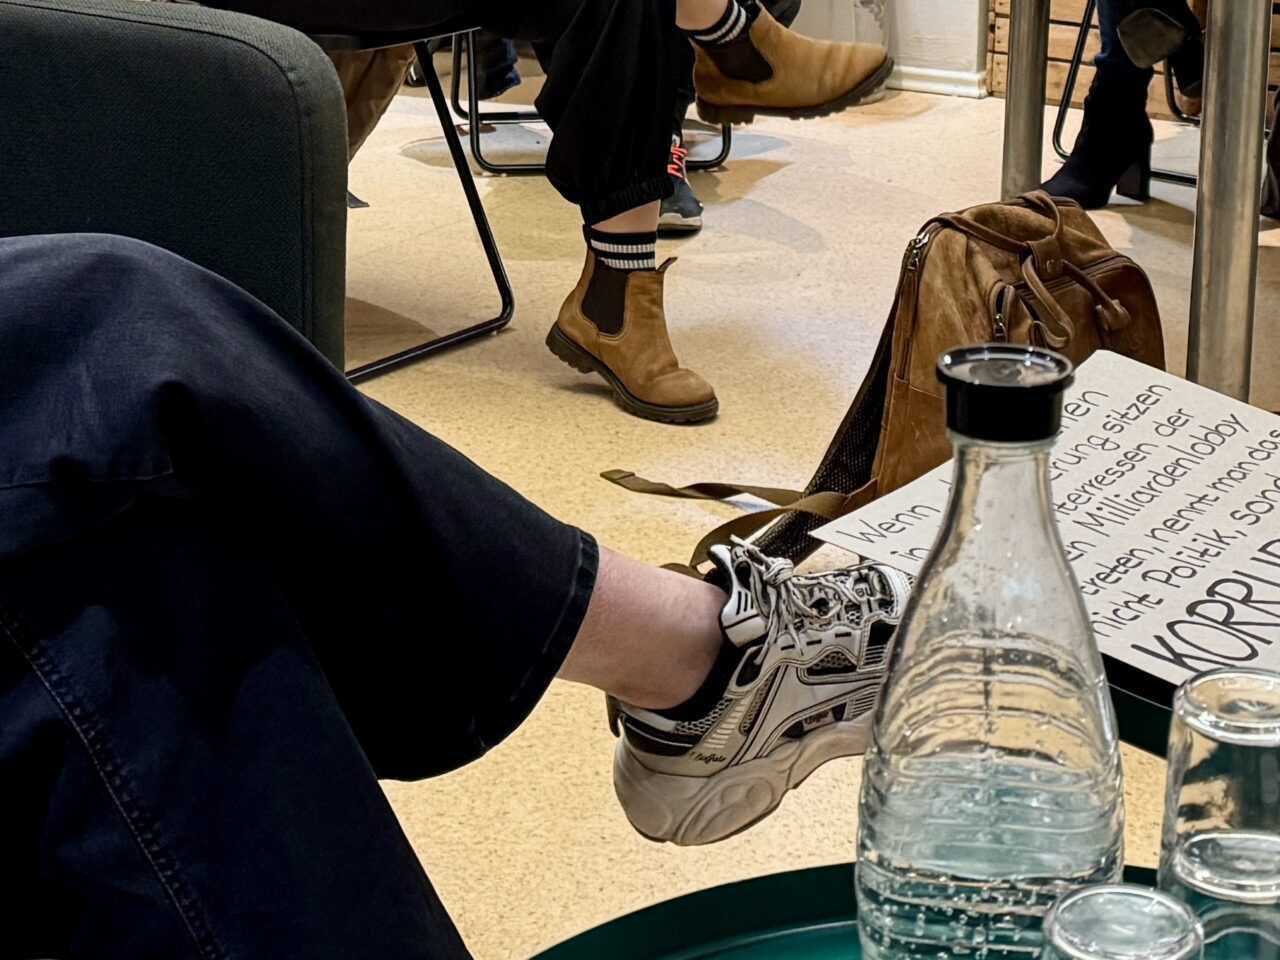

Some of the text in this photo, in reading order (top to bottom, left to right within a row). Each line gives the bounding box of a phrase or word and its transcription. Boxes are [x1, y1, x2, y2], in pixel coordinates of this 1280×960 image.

[1102, 384, 1172, 434] sitzen
[1152, 408, 1194, 437] der
[1072, 413, 1249, 538] Milliardenlobby
[836, 504, 941, 544] Wenn
[1144, 493, 1220, 543] nennt
[1091, 590, 1164, 638] nicht
[1141, 529, 1247, 588] Politik,
